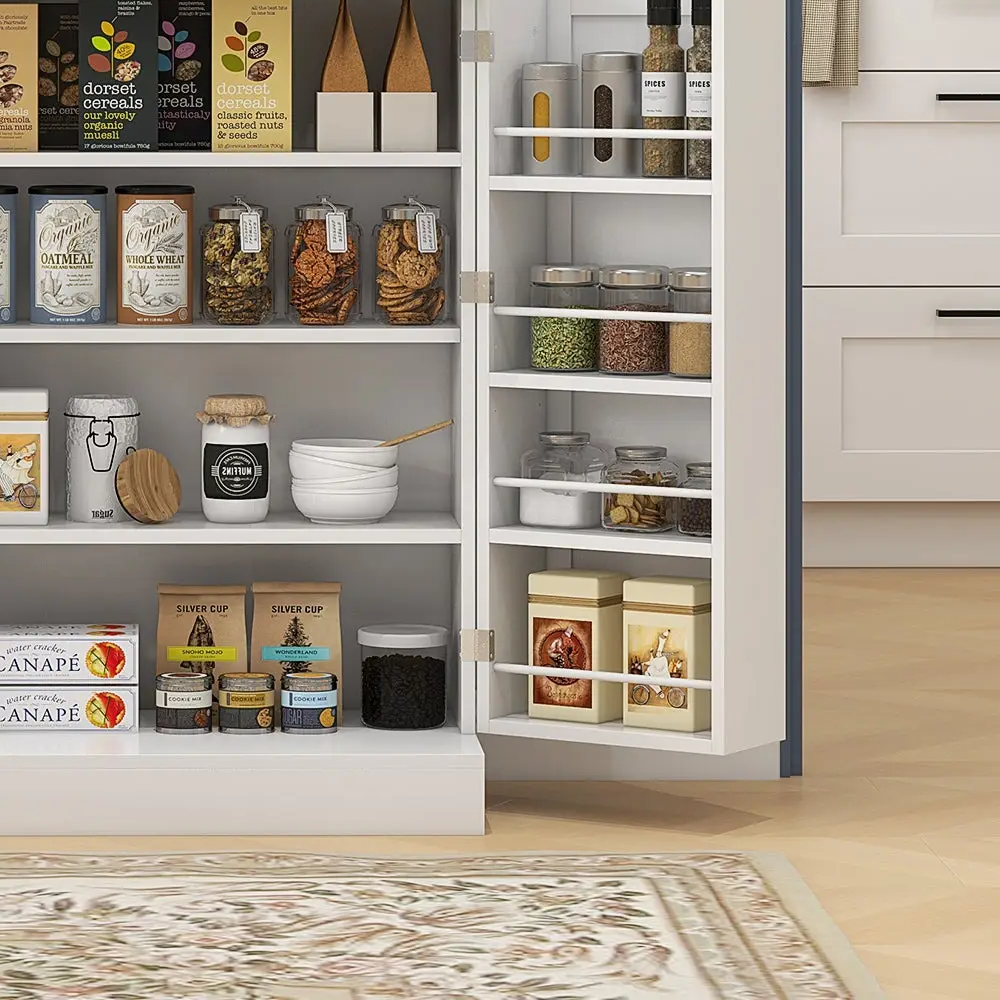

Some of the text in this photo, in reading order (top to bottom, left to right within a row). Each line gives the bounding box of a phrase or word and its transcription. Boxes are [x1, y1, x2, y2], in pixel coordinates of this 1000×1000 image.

[83, 82, 137, 95] dorset
[158, 81, 197, 94] orset
[217, 82, 270, 95] dorset
[688, 80, 711, 88] SPICES
[83, 96, 144, 109] cereals
[158, 95, 204, 108] reals
[216, 96, 277, 109] cereals
[40, 106, 79, 115] set cere
[158, 110, 211, 120] ntasticaly
[217, 111, 288, 120] classic fruits,
[0, 116, 31, 124] granola
[83, 111, 136, 121] our lovely
[83, 121, 124, 131] organic
[217, 121, 284, 130] roasted nuts
[83, 131, 120, 140] muesli
[217, 130, 258, 140] & seeds
[39, 212, 92, 250] Organic
[126, 212, 180, 250] Organic
[40, 252, 94, 265] OATMEAL
[126, 254, 185, 264] WHOLE WHEAT
[176, 604, 229, 613] SILVER CUP
[271, 605, 324, 614] SILVER CUP
[6, 643, 67, 655] water cracker
[6, 693, 67, 705] water cracker
